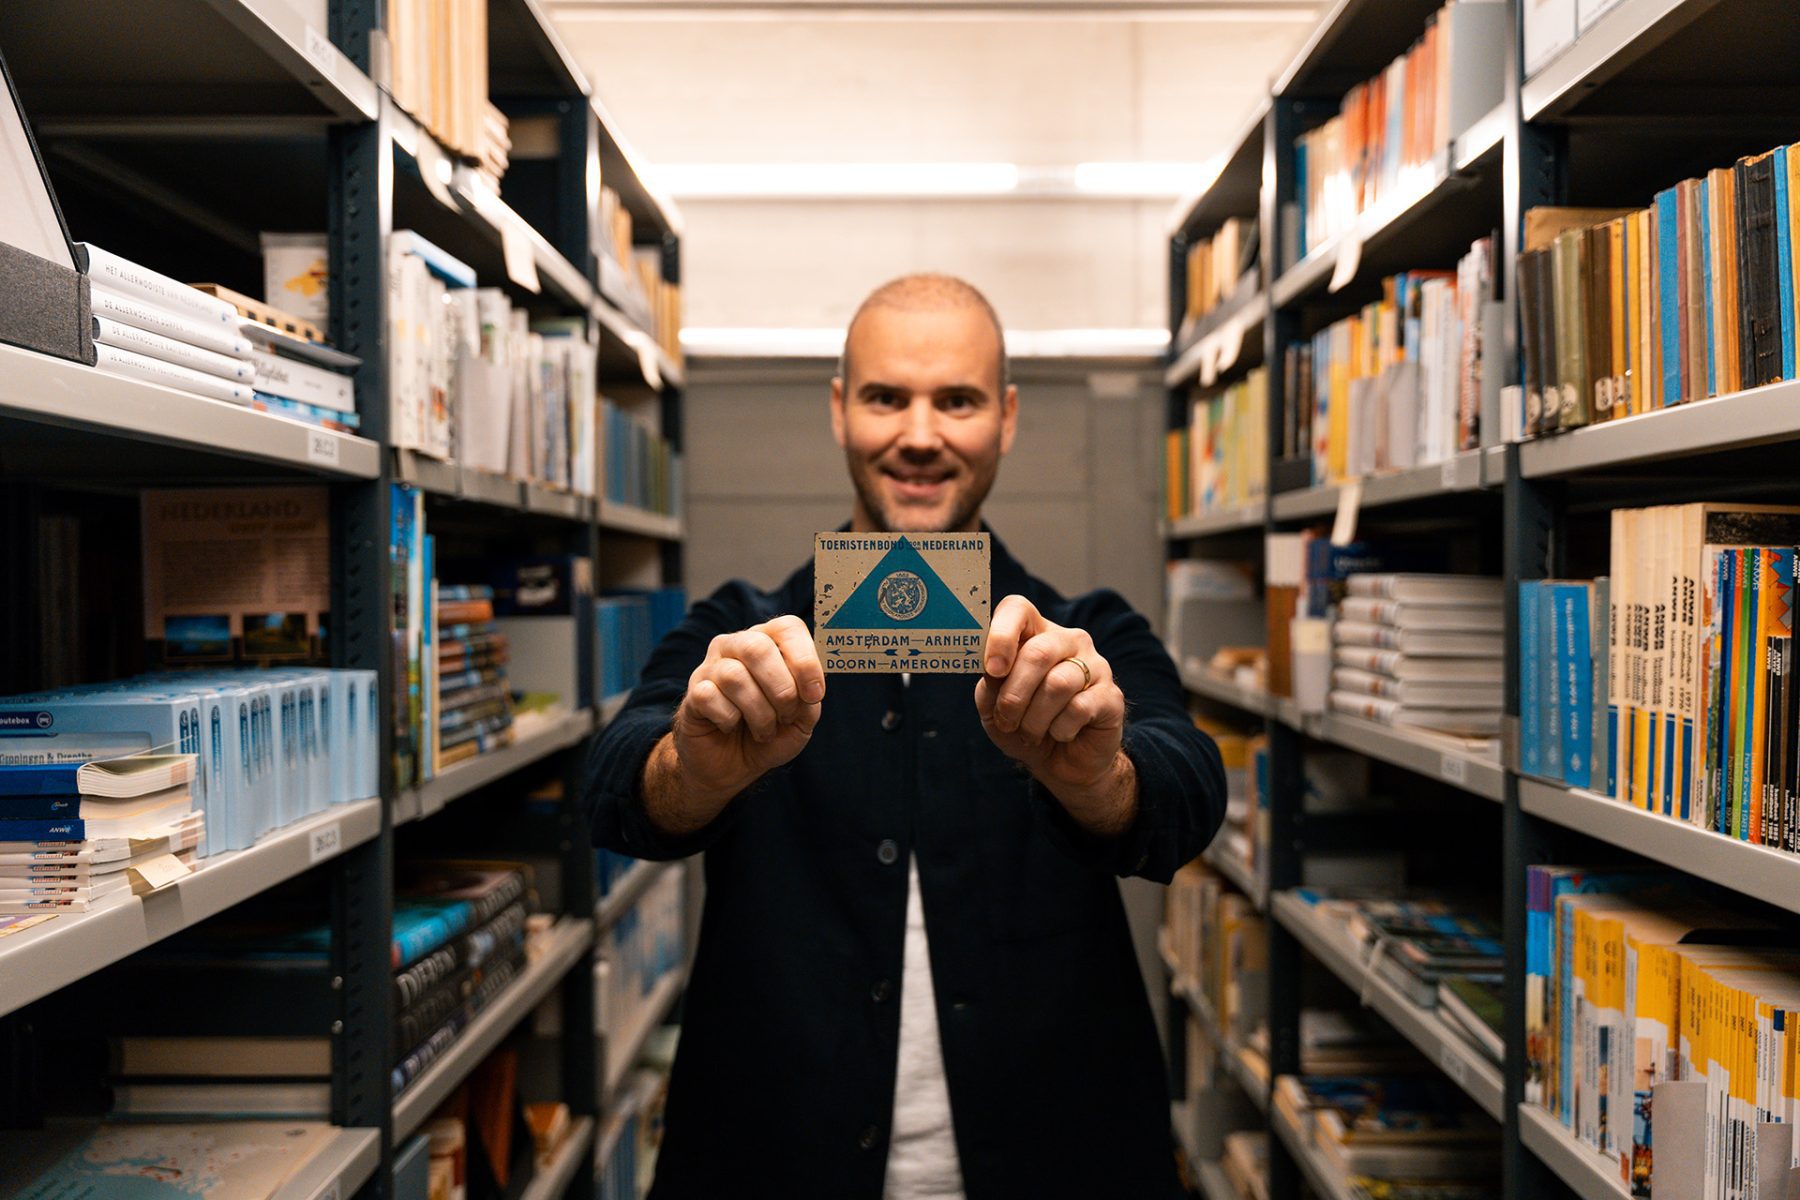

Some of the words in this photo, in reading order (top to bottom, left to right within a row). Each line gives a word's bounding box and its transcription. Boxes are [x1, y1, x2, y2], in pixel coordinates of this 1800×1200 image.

[105, 264, 118, 275] HET
[119, 271, 165, 296] ALLERMOOISTE
[821, 540, 904, 550] TOERISTENBOND
[922, 540, 984, 550] NEDERLAND
